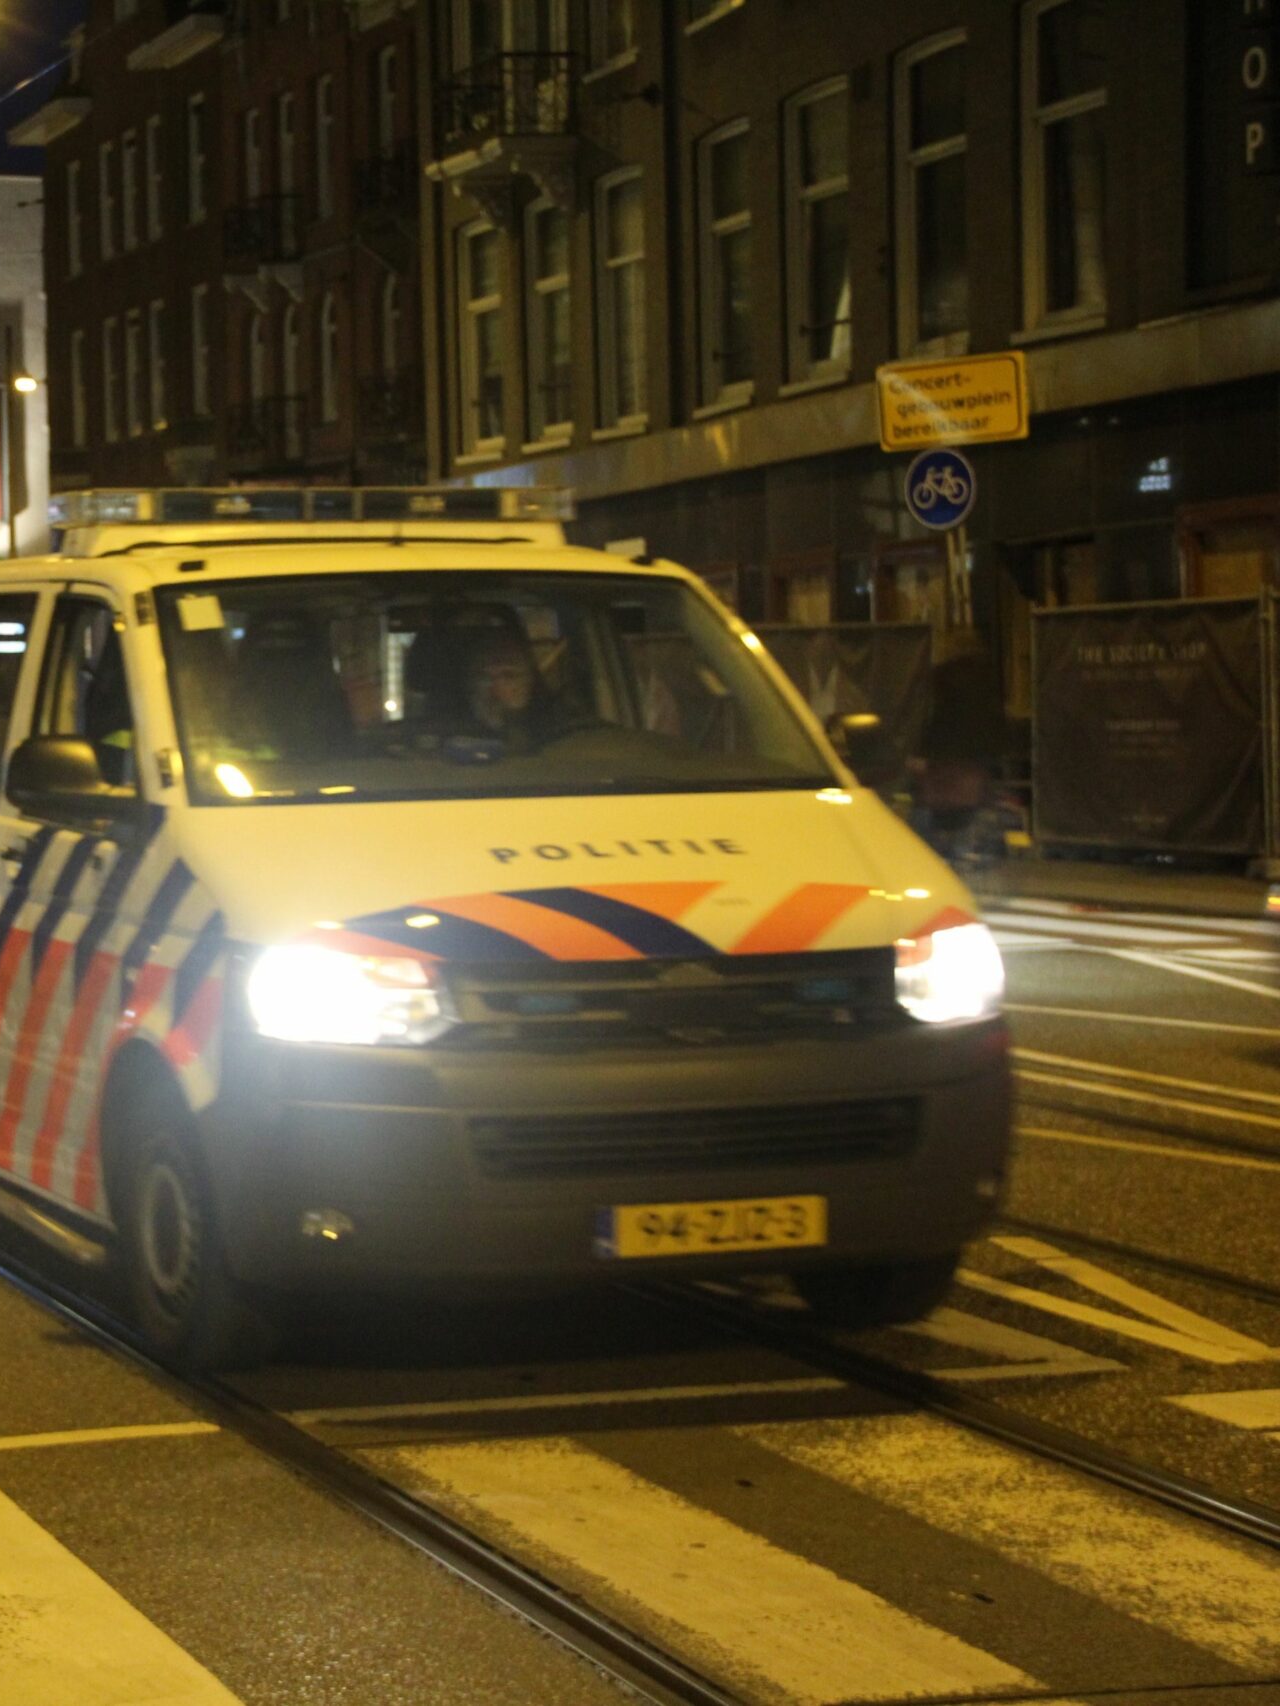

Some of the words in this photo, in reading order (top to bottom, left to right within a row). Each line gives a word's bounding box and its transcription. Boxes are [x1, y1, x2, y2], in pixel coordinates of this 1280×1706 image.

[896, 391, 1012, 419] gebouwplein
[892, 416, 988, 439] bereikbaar
[488, 837, 748, 864] POLITIE
